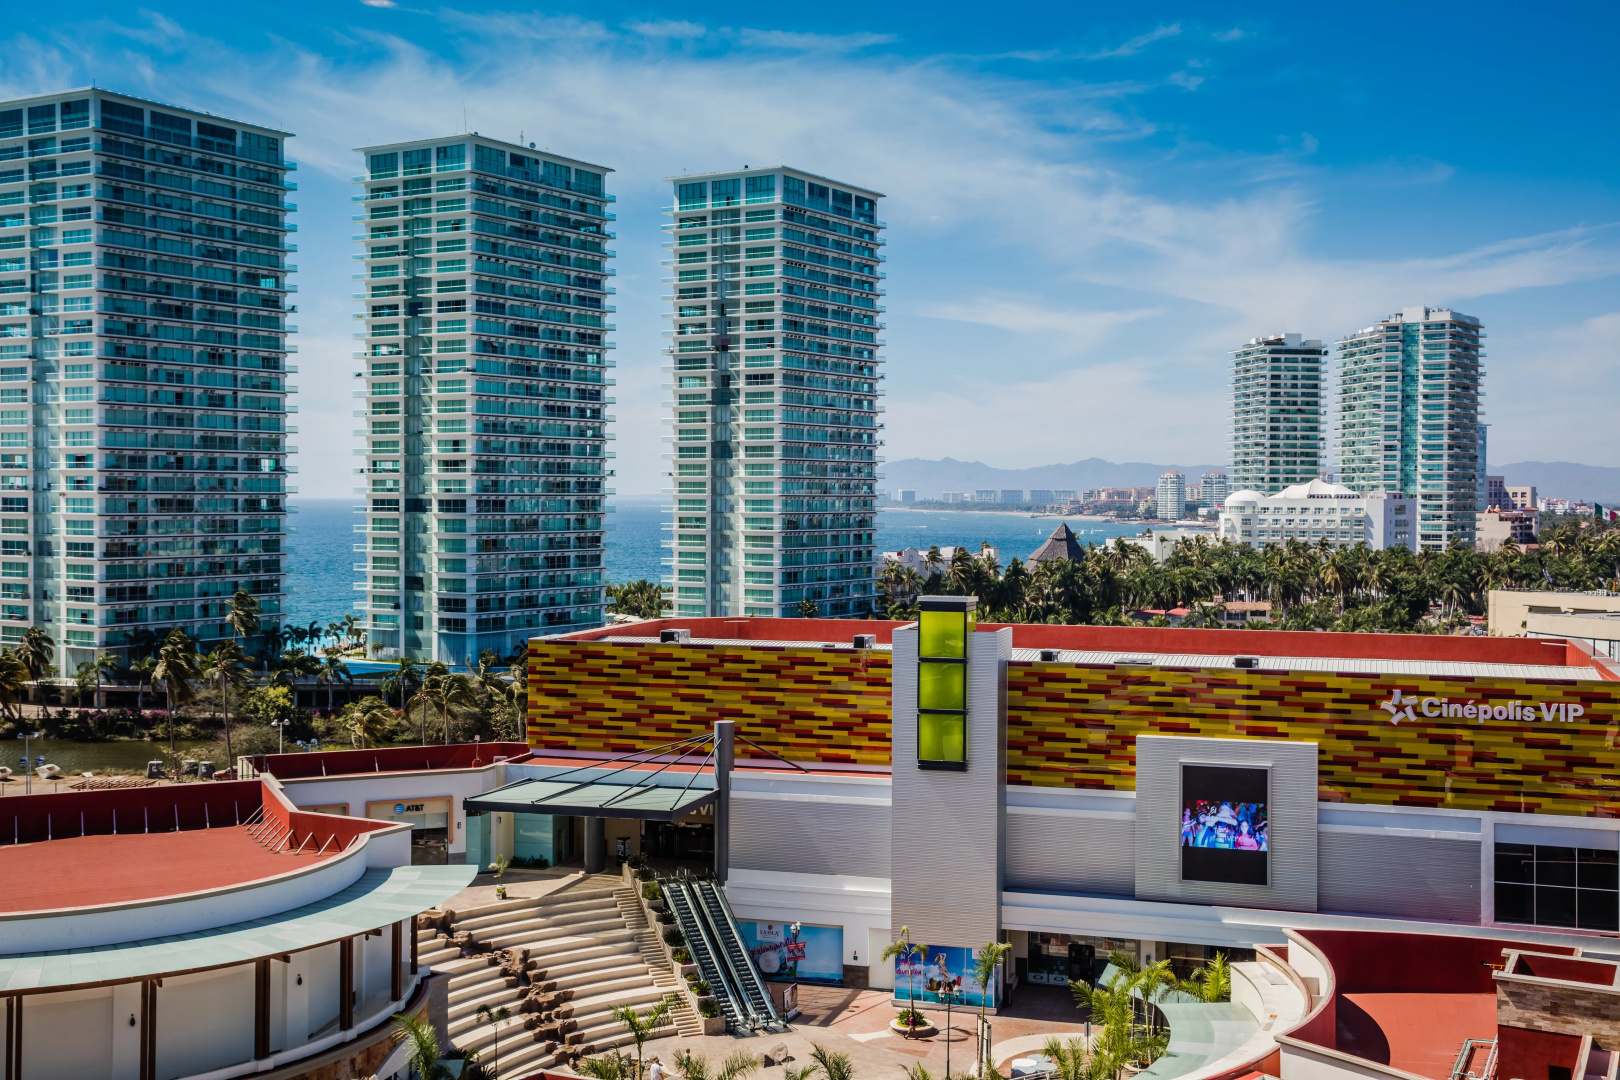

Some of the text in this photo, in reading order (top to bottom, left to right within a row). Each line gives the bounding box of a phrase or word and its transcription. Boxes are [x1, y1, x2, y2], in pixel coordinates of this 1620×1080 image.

[1421, 698, 1585, 723] Cinépolis VIP
[406, 804, 424, 812] AT&T
[699, 803, 714, 816] VI
